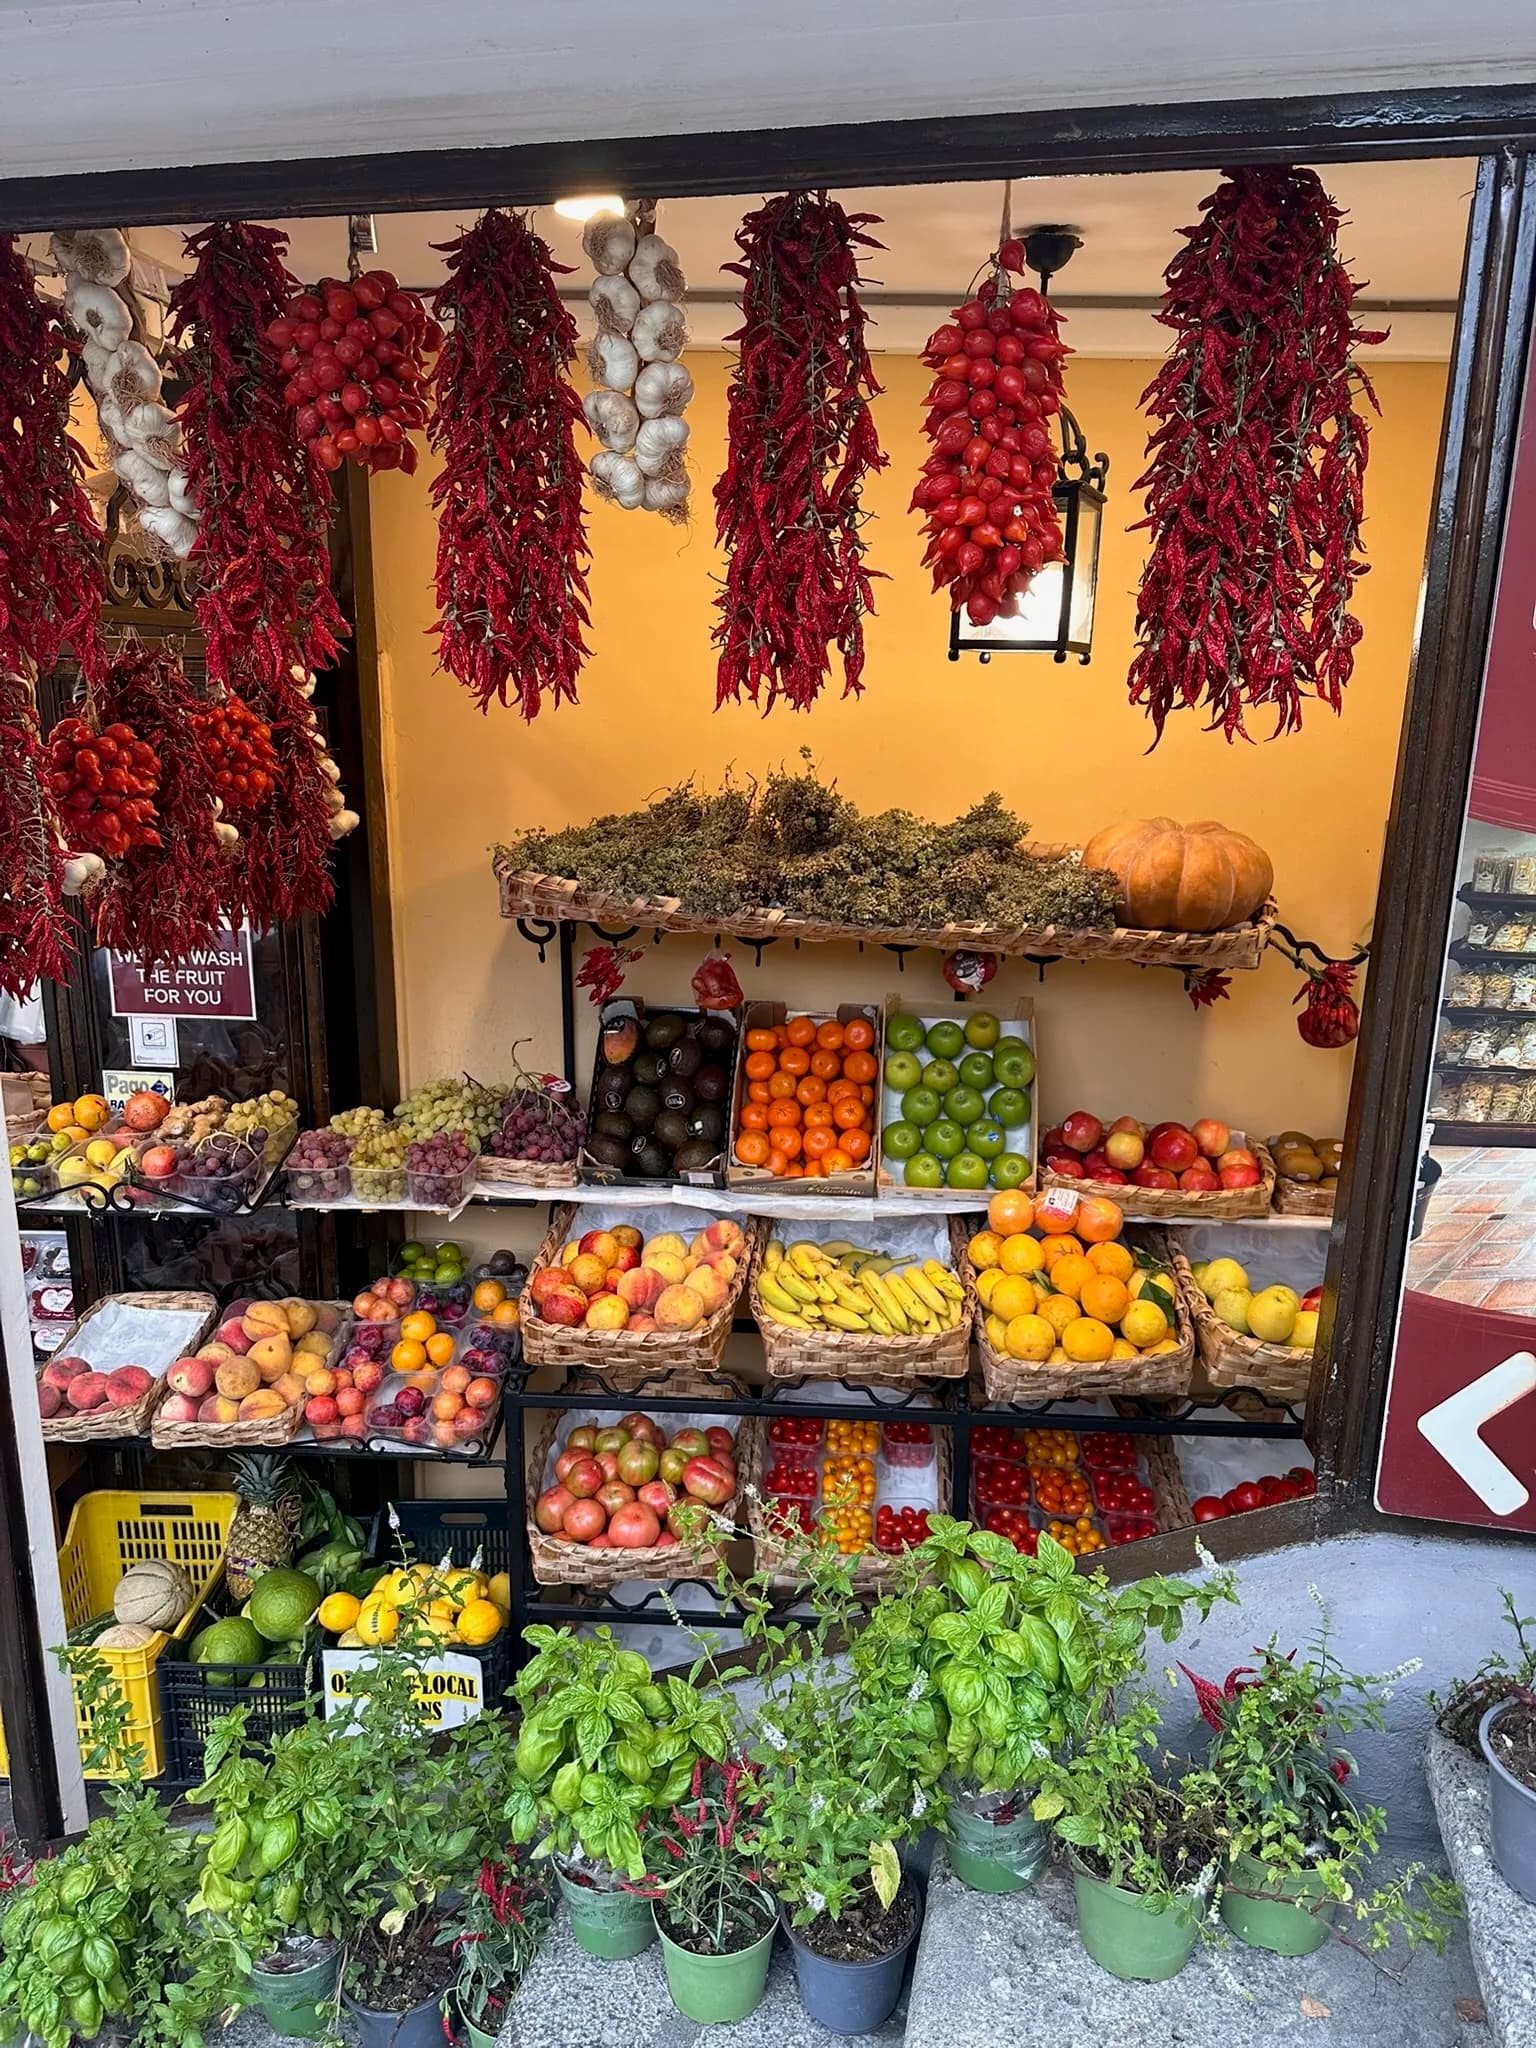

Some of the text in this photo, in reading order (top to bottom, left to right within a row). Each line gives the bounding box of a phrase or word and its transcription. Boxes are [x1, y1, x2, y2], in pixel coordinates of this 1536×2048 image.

[190, 950, 243, 967] WASH
[136, 968, 226, 986] THE FRUIT
[143, 988, 222, 1006] FOR YOU
[107, 1074, 149, 1095] Pago
[422, 1674, 478, 1700] LOCAL
